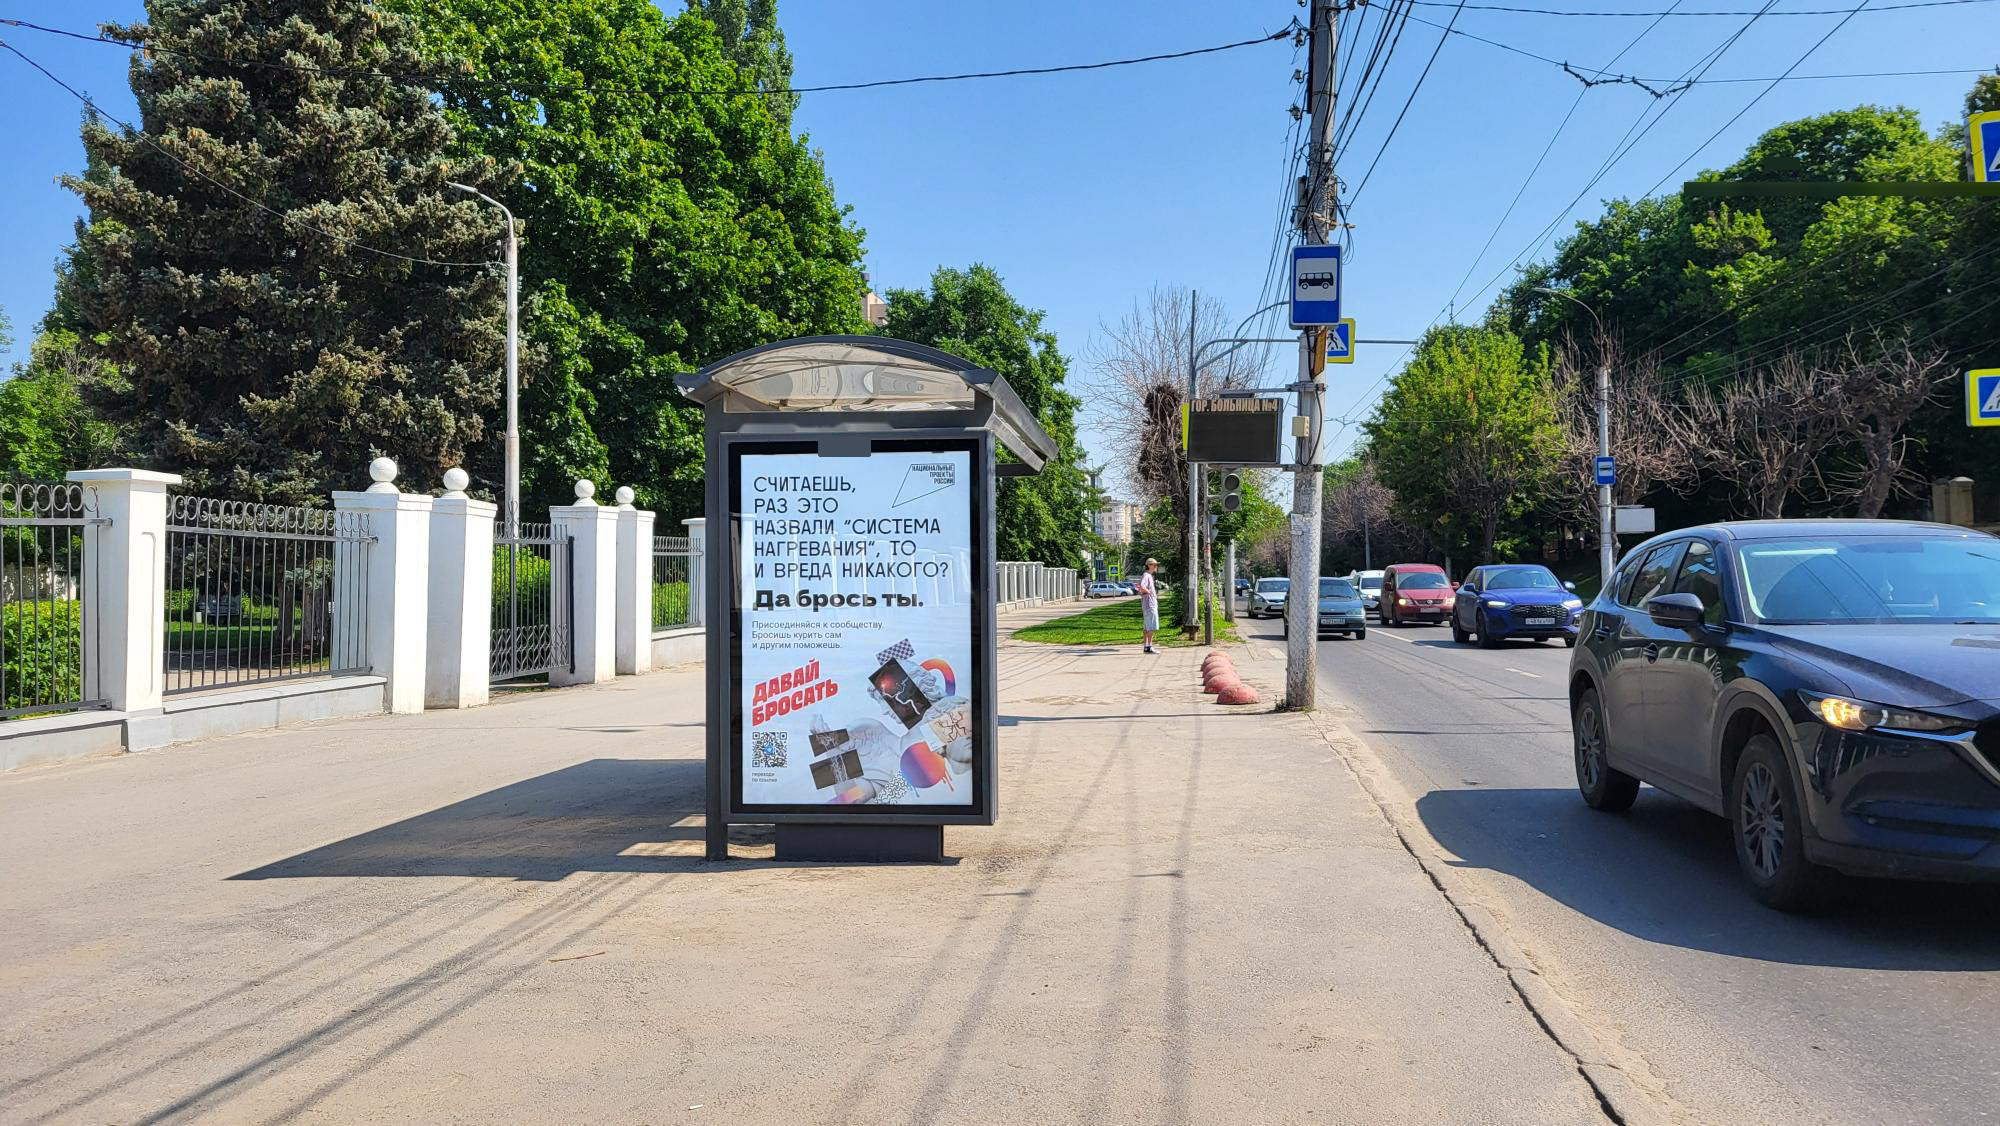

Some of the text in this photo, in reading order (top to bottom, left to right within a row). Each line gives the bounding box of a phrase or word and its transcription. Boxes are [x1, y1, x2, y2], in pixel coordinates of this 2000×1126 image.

[1191, 400, 1278, 413] ГОР. БОЛЬНИЦА №4
[753, 476, 856, 493] СЧИТАЕШЬ,
[754, 497, 839, 513] РАЗ ЭТО
[754, 519, 835, 535] НАЗВАЛИ
[890, 540, 917, 556] ТО
[754, 561, 949, 580] И ВРЕДА НИКАКОГО?
[752, 589, 924, 612] Да брось ты.
[752, 620, 821, 630] Присоединяйся
[752, 630, 842, 641] Бросишь курить сам
[760, 641, 792, 650] другим
[793, 641, 842, 649] поможешь.
[752, 657, 820, 706] ДАВАЙ
[752, 678, 839, 727] БРОСАТЬ
